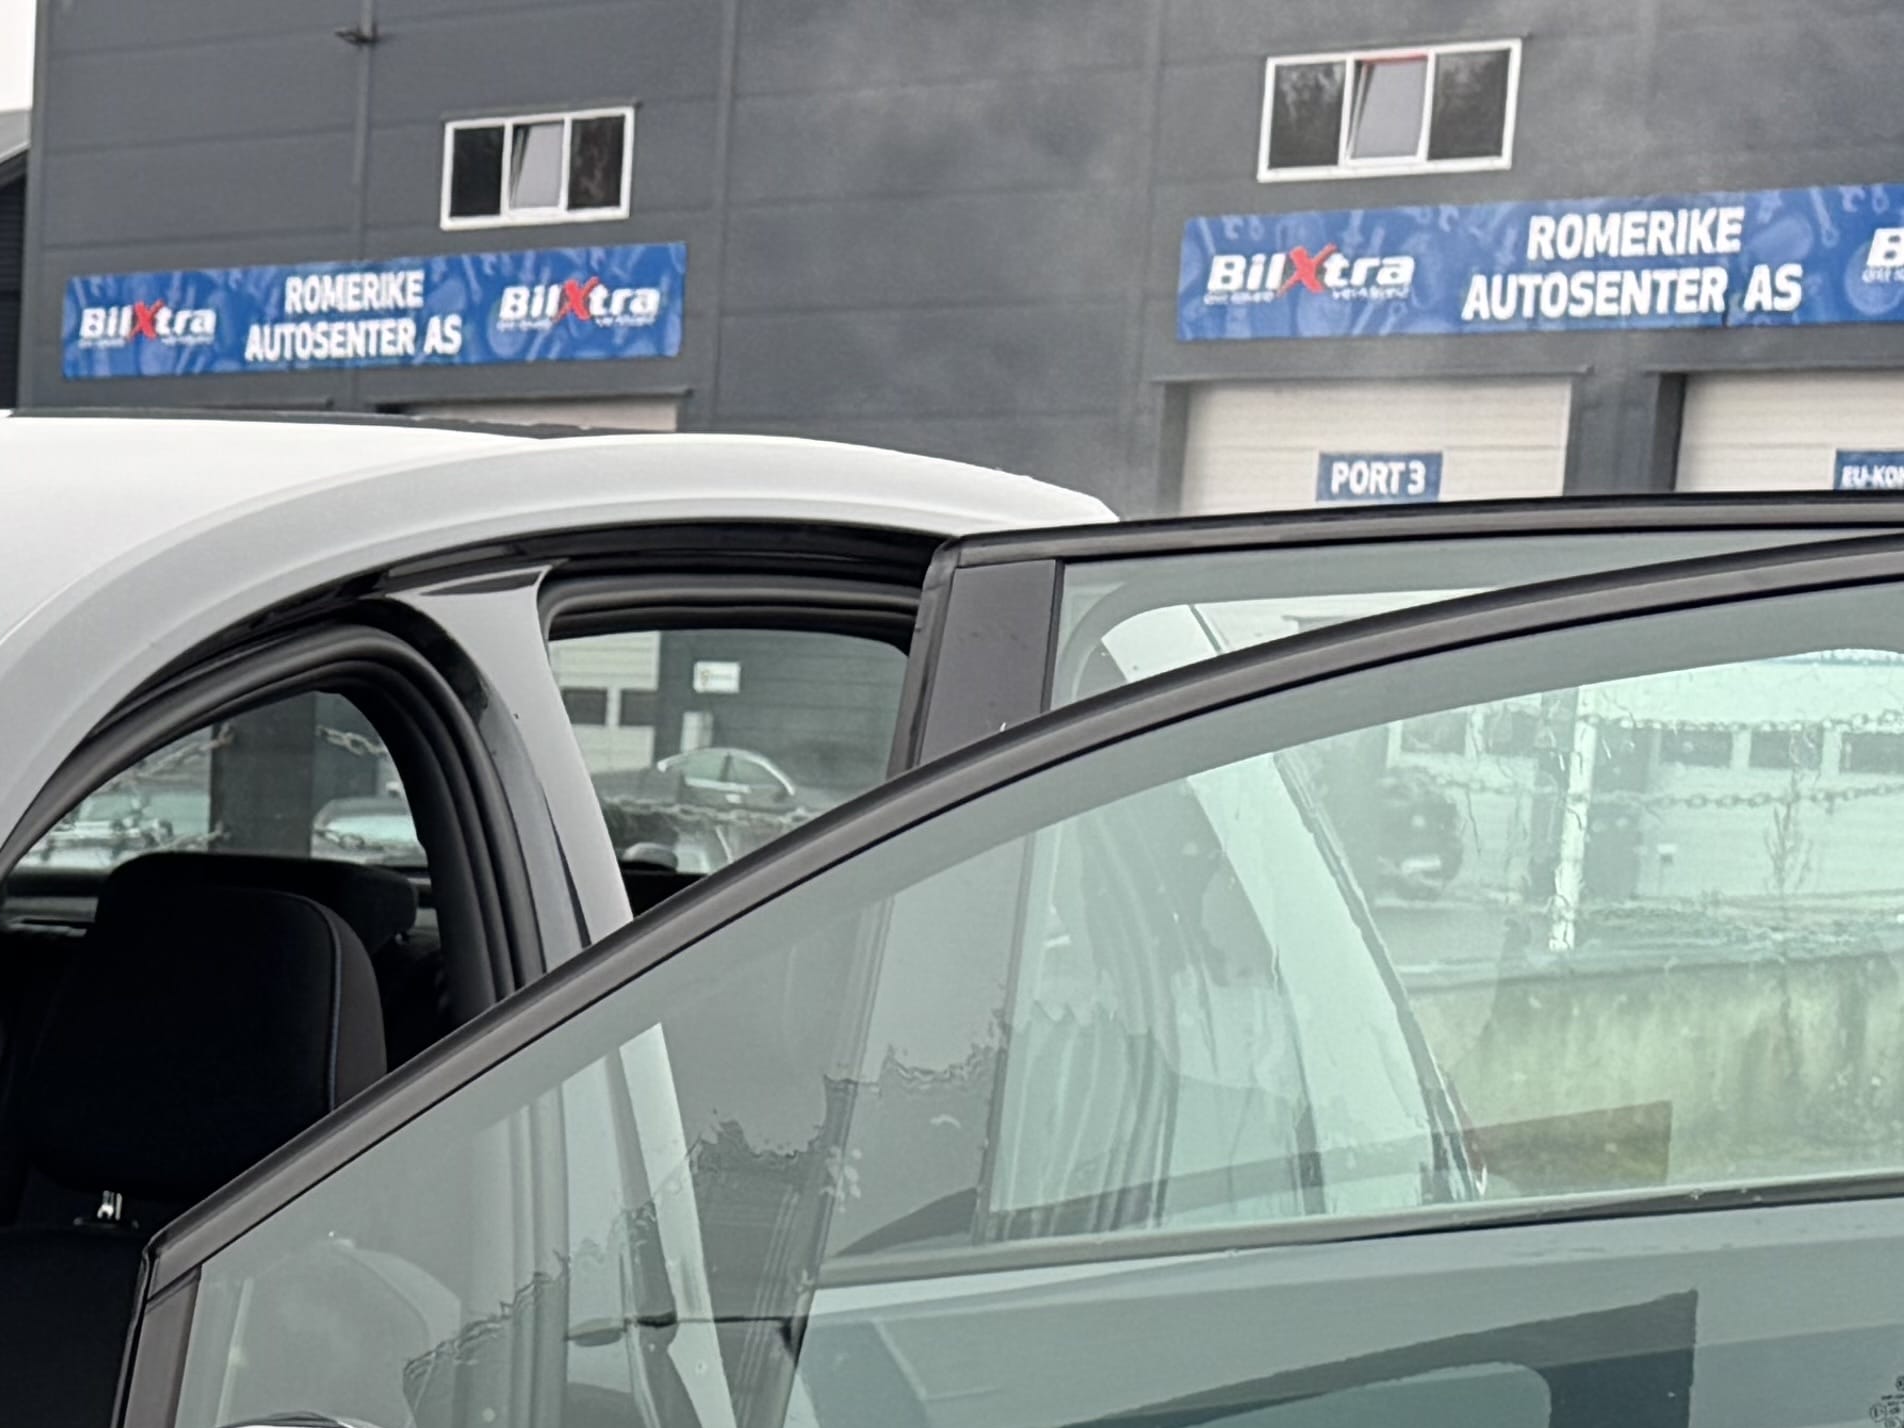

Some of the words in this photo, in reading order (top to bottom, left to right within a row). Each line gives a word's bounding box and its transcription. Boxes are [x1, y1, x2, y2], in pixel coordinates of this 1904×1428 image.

[1527, 206, 1745, 261] ROMERIKE
[285, 270, 425, 314] ROMERIKE
[1207, 243, 1415, 295] BilXtra
[499, 277, 661, 321] BilXtra
[1461, 266, 1729, 321] AUTOSENTER
[1743, 264, 1803, 312] AS
[79, 299, 217, 341] BilXtra
[245, 318, 417, 362] AUTOSENTER
[423, 314, 463, 355] AS
[1331, 460, 1406, 495] PORT
[1407, 459, 1426, 495] 3
